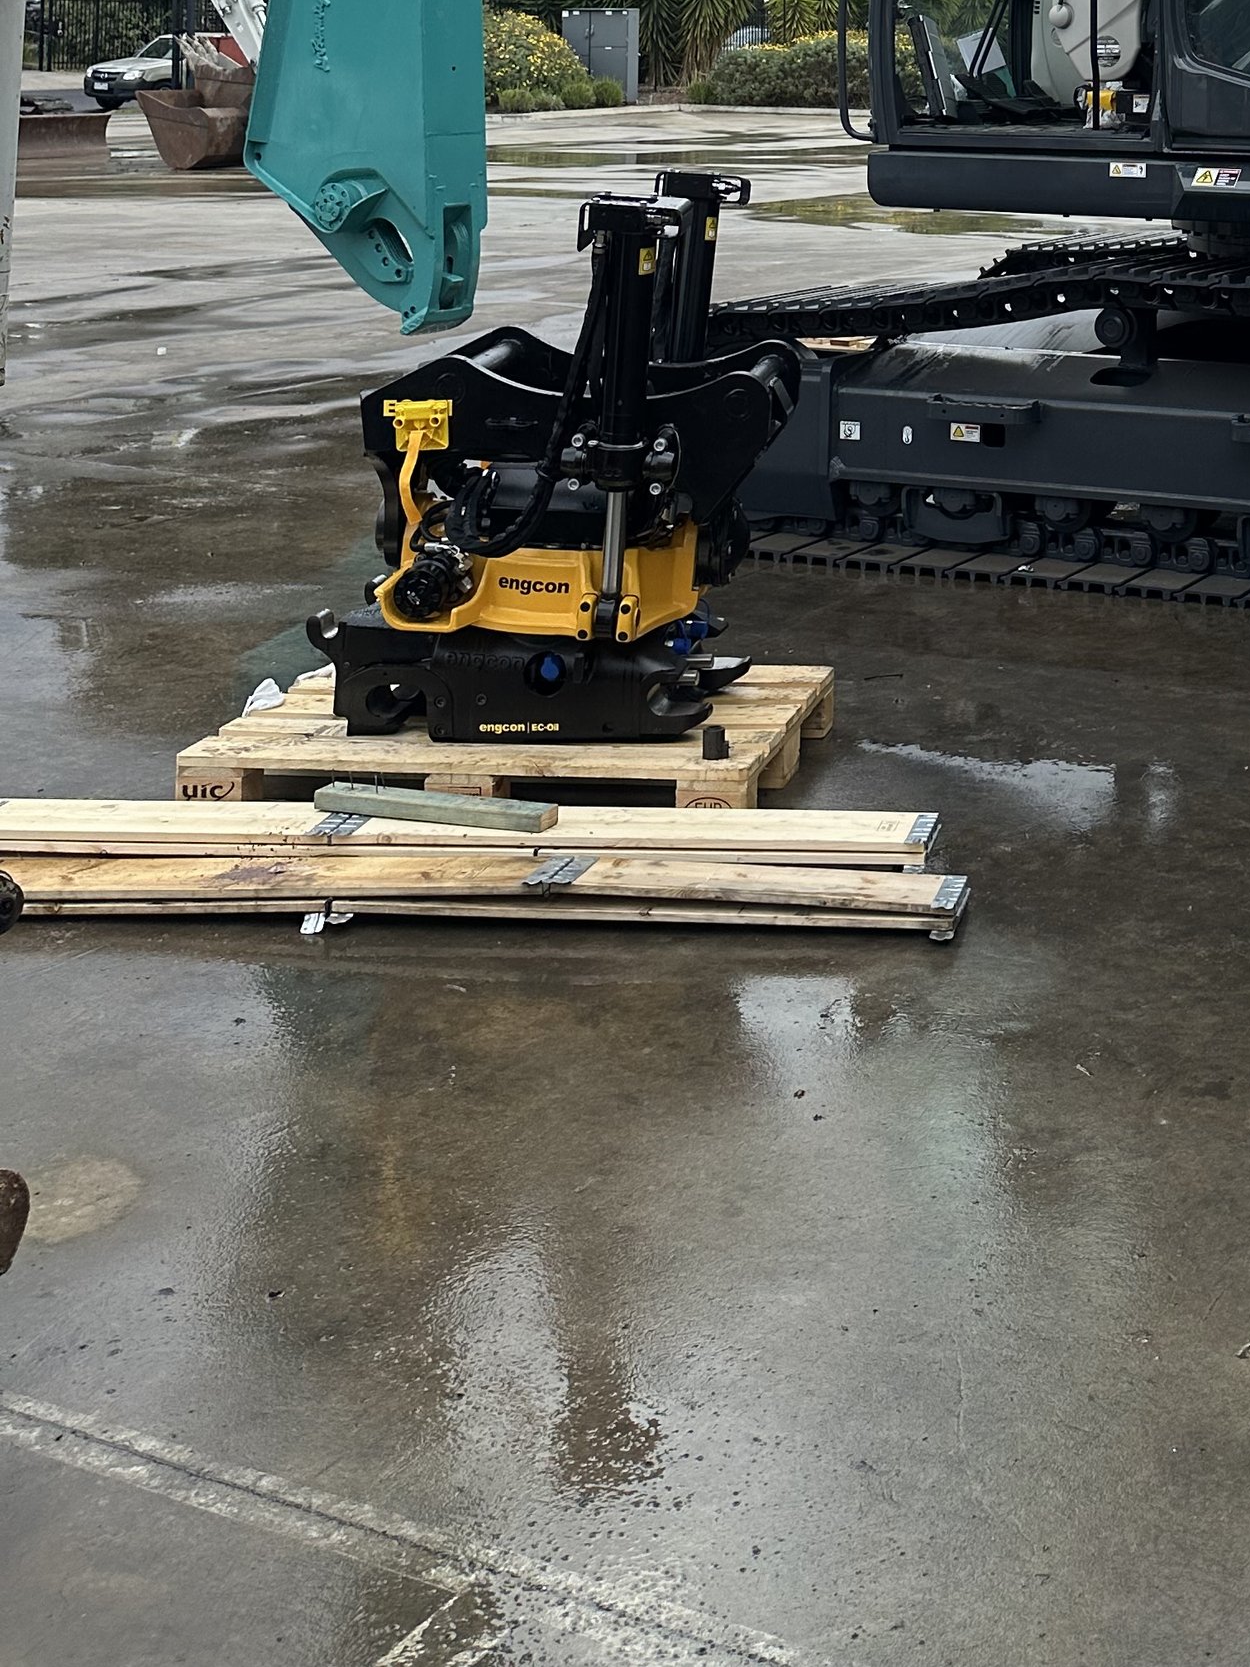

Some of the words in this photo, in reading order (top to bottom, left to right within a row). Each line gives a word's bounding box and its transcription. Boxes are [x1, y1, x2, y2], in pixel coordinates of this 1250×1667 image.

[498, 576, 570, 595] engcon
[479, 724, 526, 734] engcon
[531, 723, 560, 732] EC-Oil
